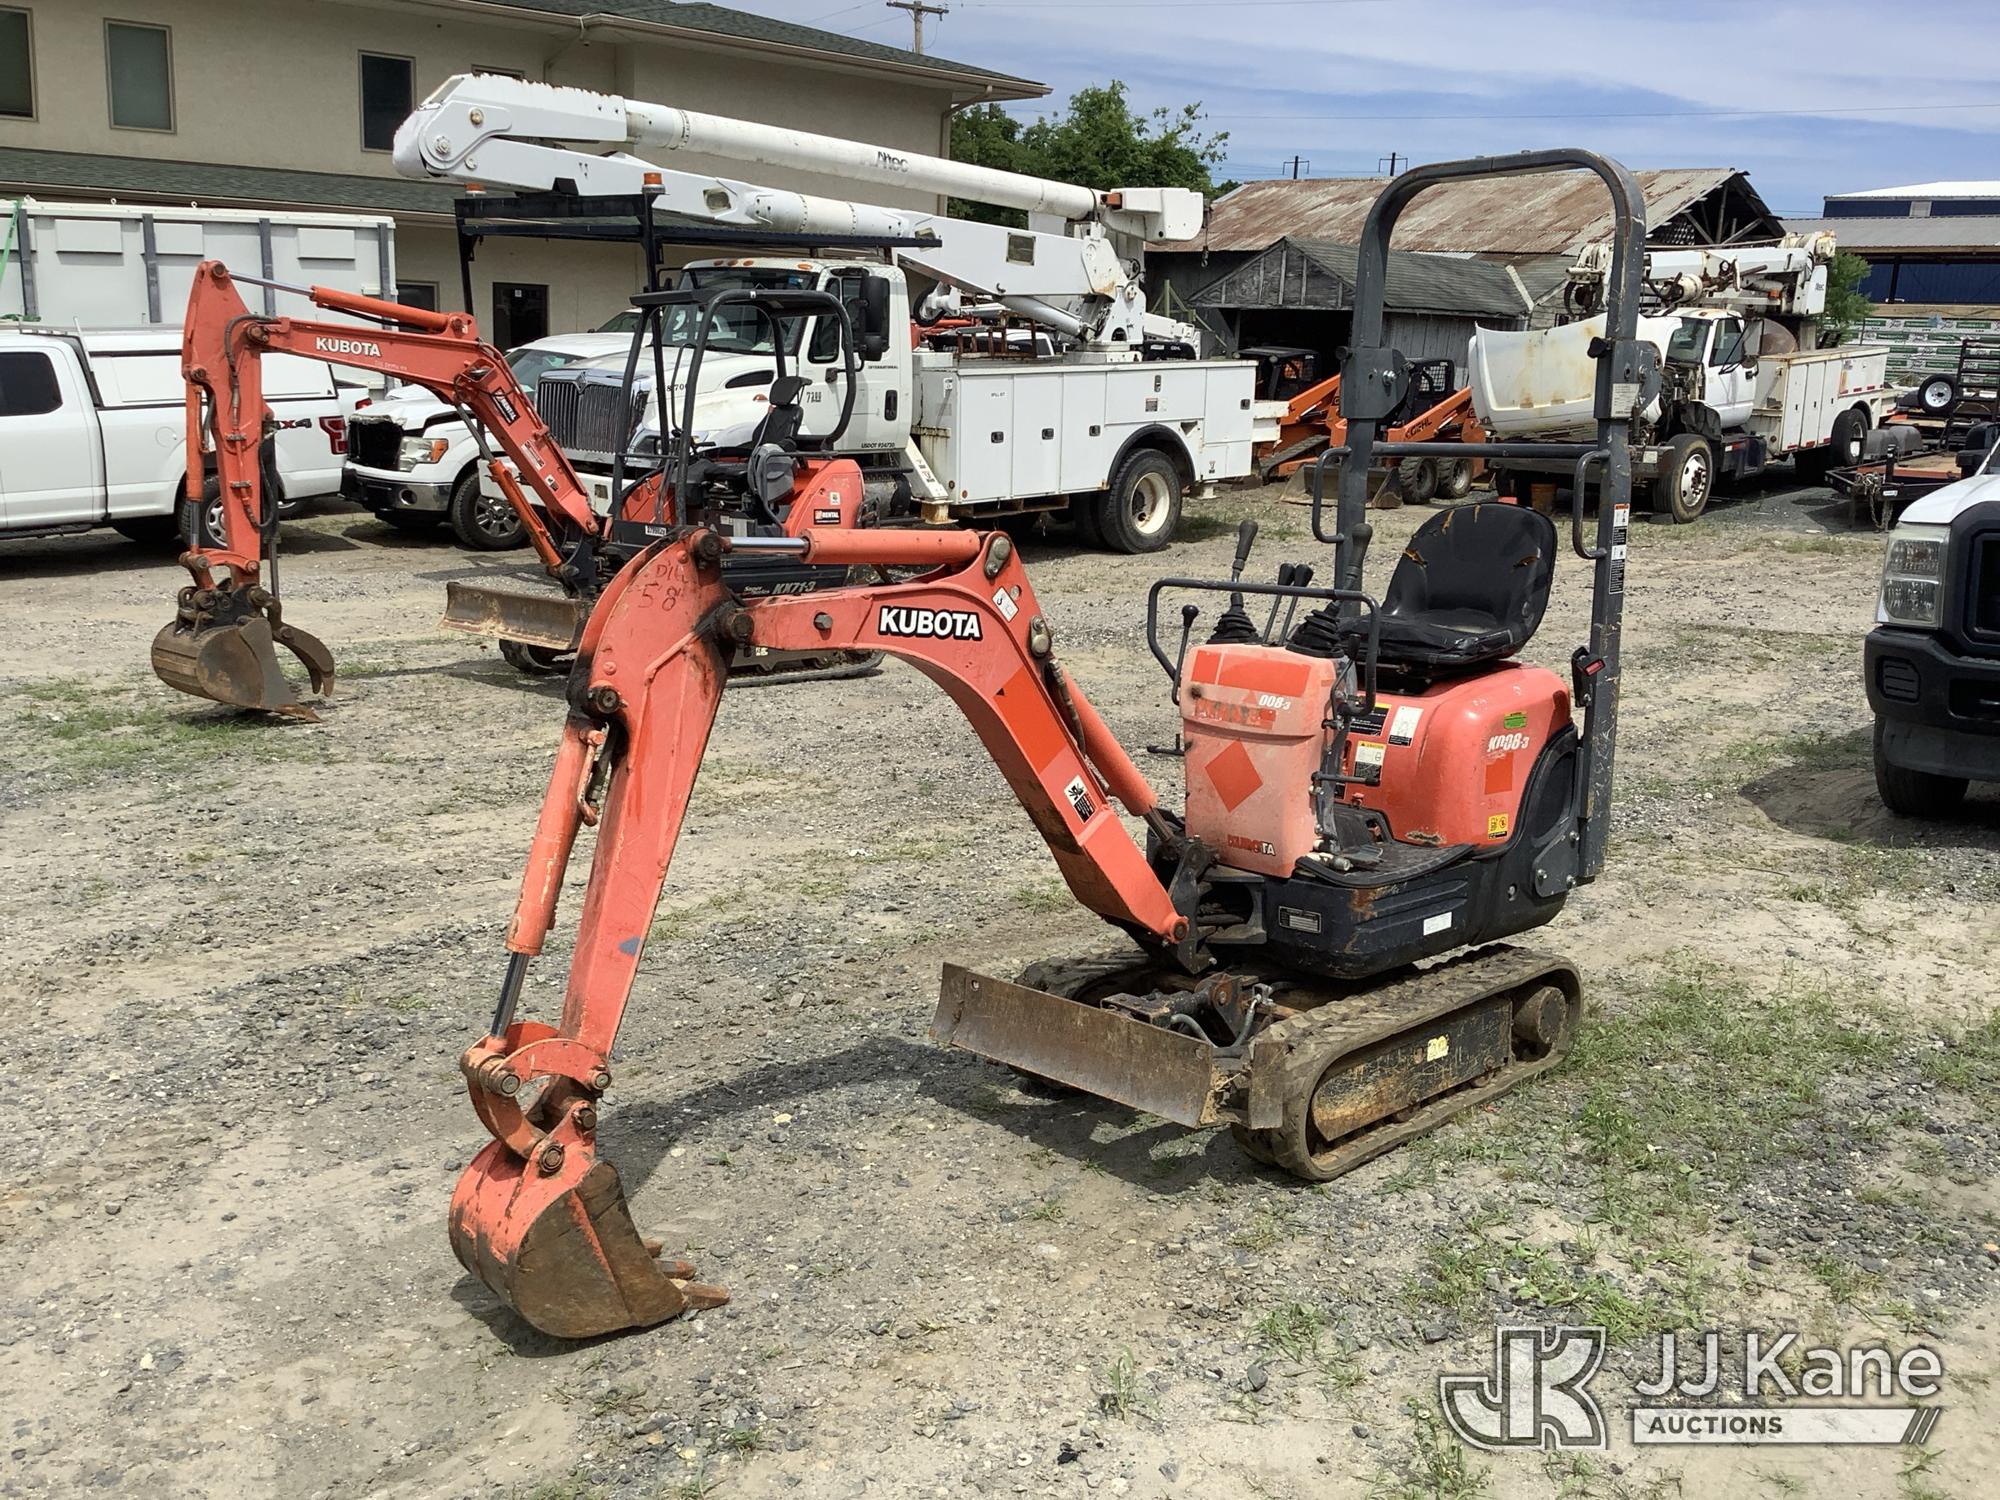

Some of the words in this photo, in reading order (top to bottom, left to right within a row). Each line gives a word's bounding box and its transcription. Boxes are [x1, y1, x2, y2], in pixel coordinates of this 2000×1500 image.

[315, 336, 382, 357] KUBOTA
[771, 581, 817, 595] KX71-3
[879, 607, 982, 640] KUBOTA
[1259, 694, 1291, 711] 008-3
